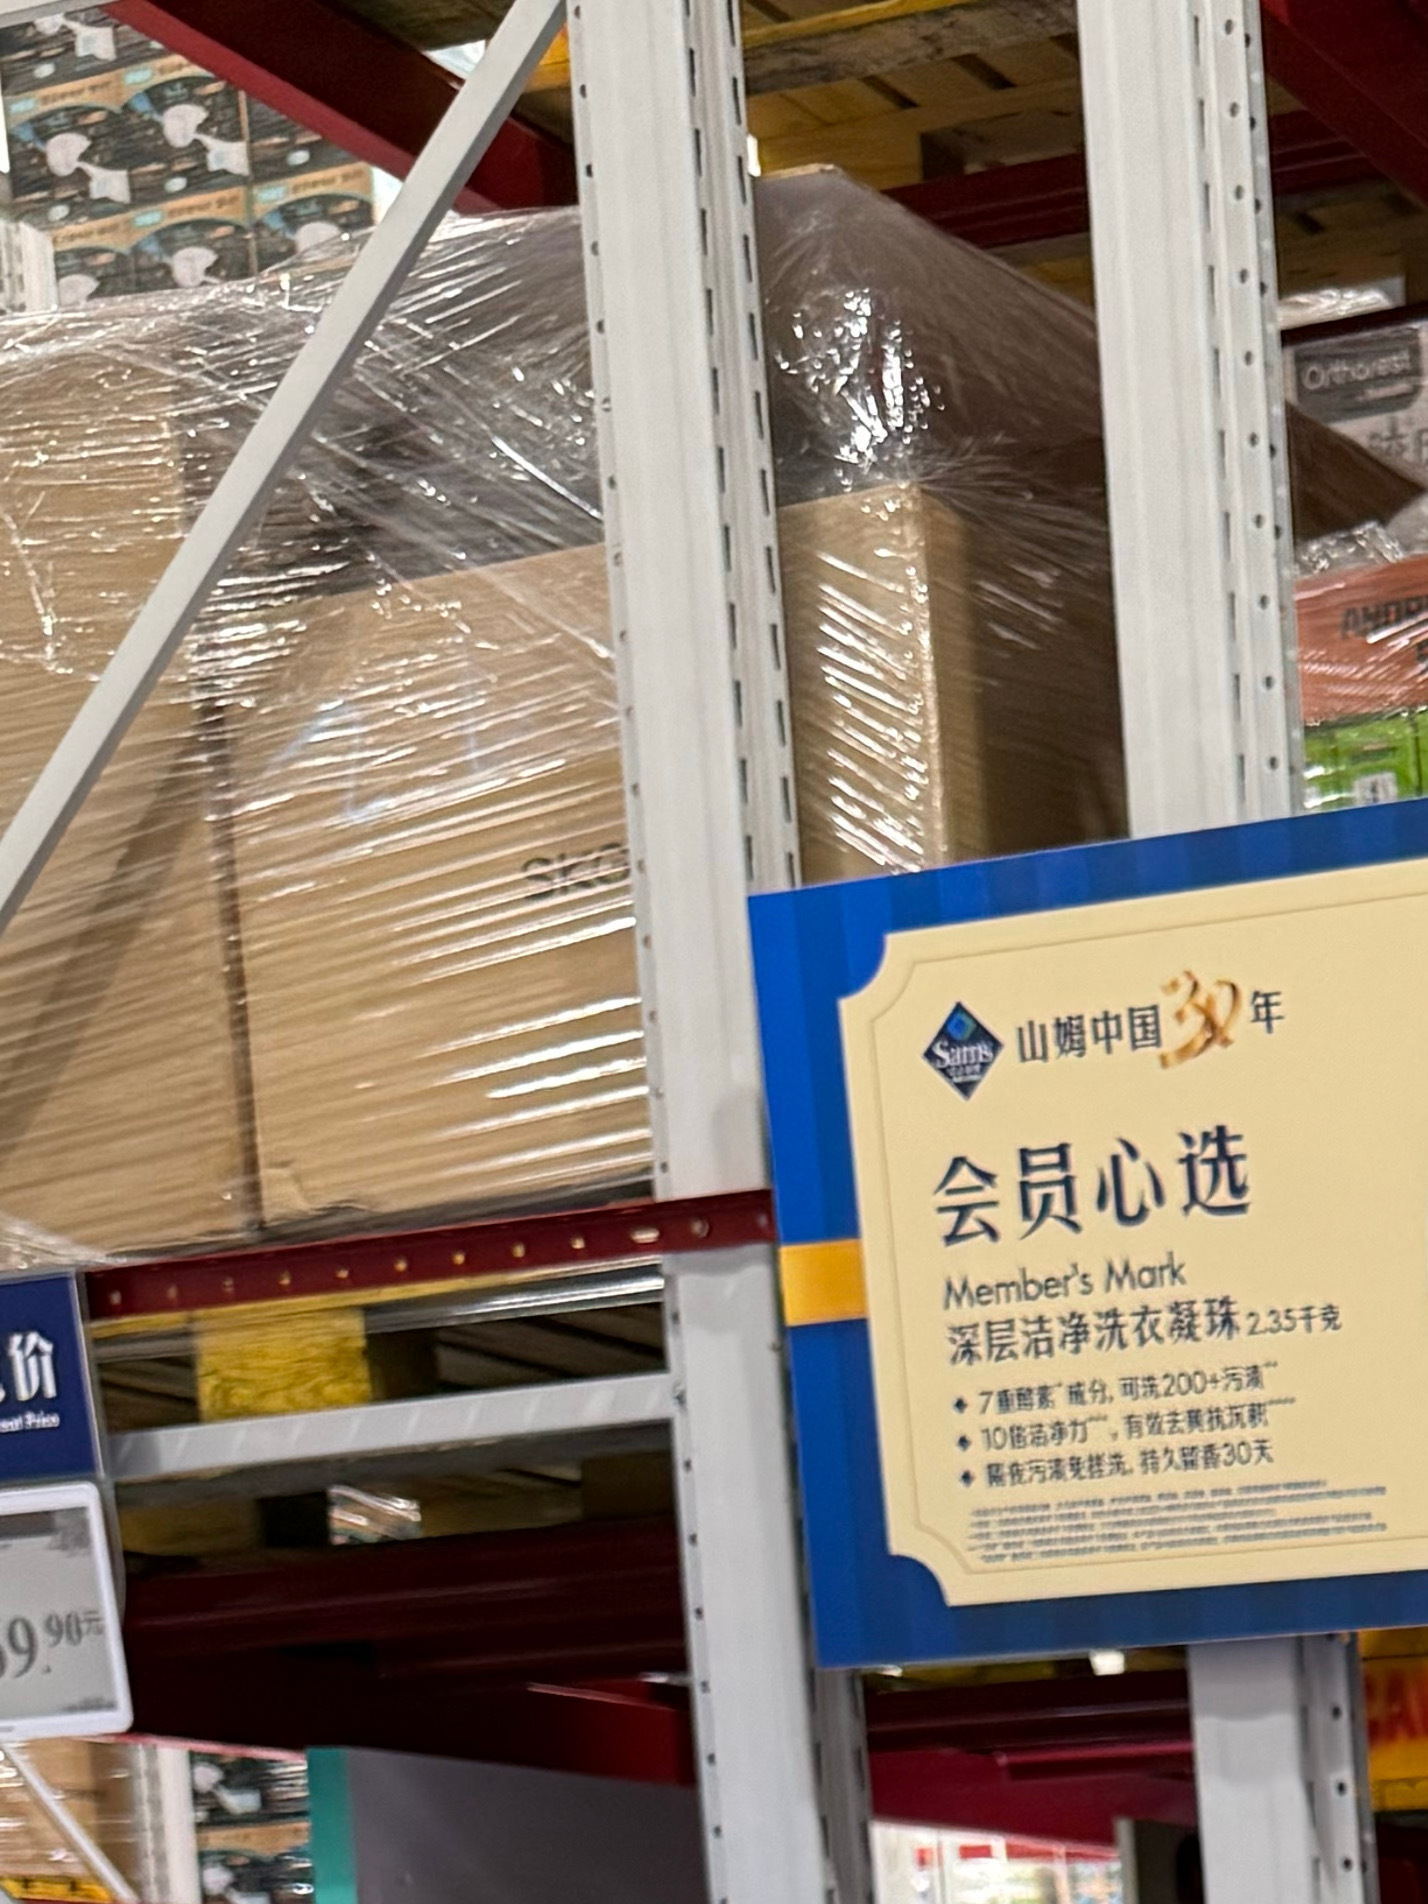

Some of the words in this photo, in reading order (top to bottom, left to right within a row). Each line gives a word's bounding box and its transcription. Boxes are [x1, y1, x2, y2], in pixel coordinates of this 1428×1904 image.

[933, 1125, 1250, 1247] 会员心选
[943, 1263, 1094, 1311] Member's
[1104, 1251, 1187, 1293] Mark
[947, 1295, 1240, 1366] 深层洁净洗衣凝珠
[0, 1331, 57, 1402] 价
